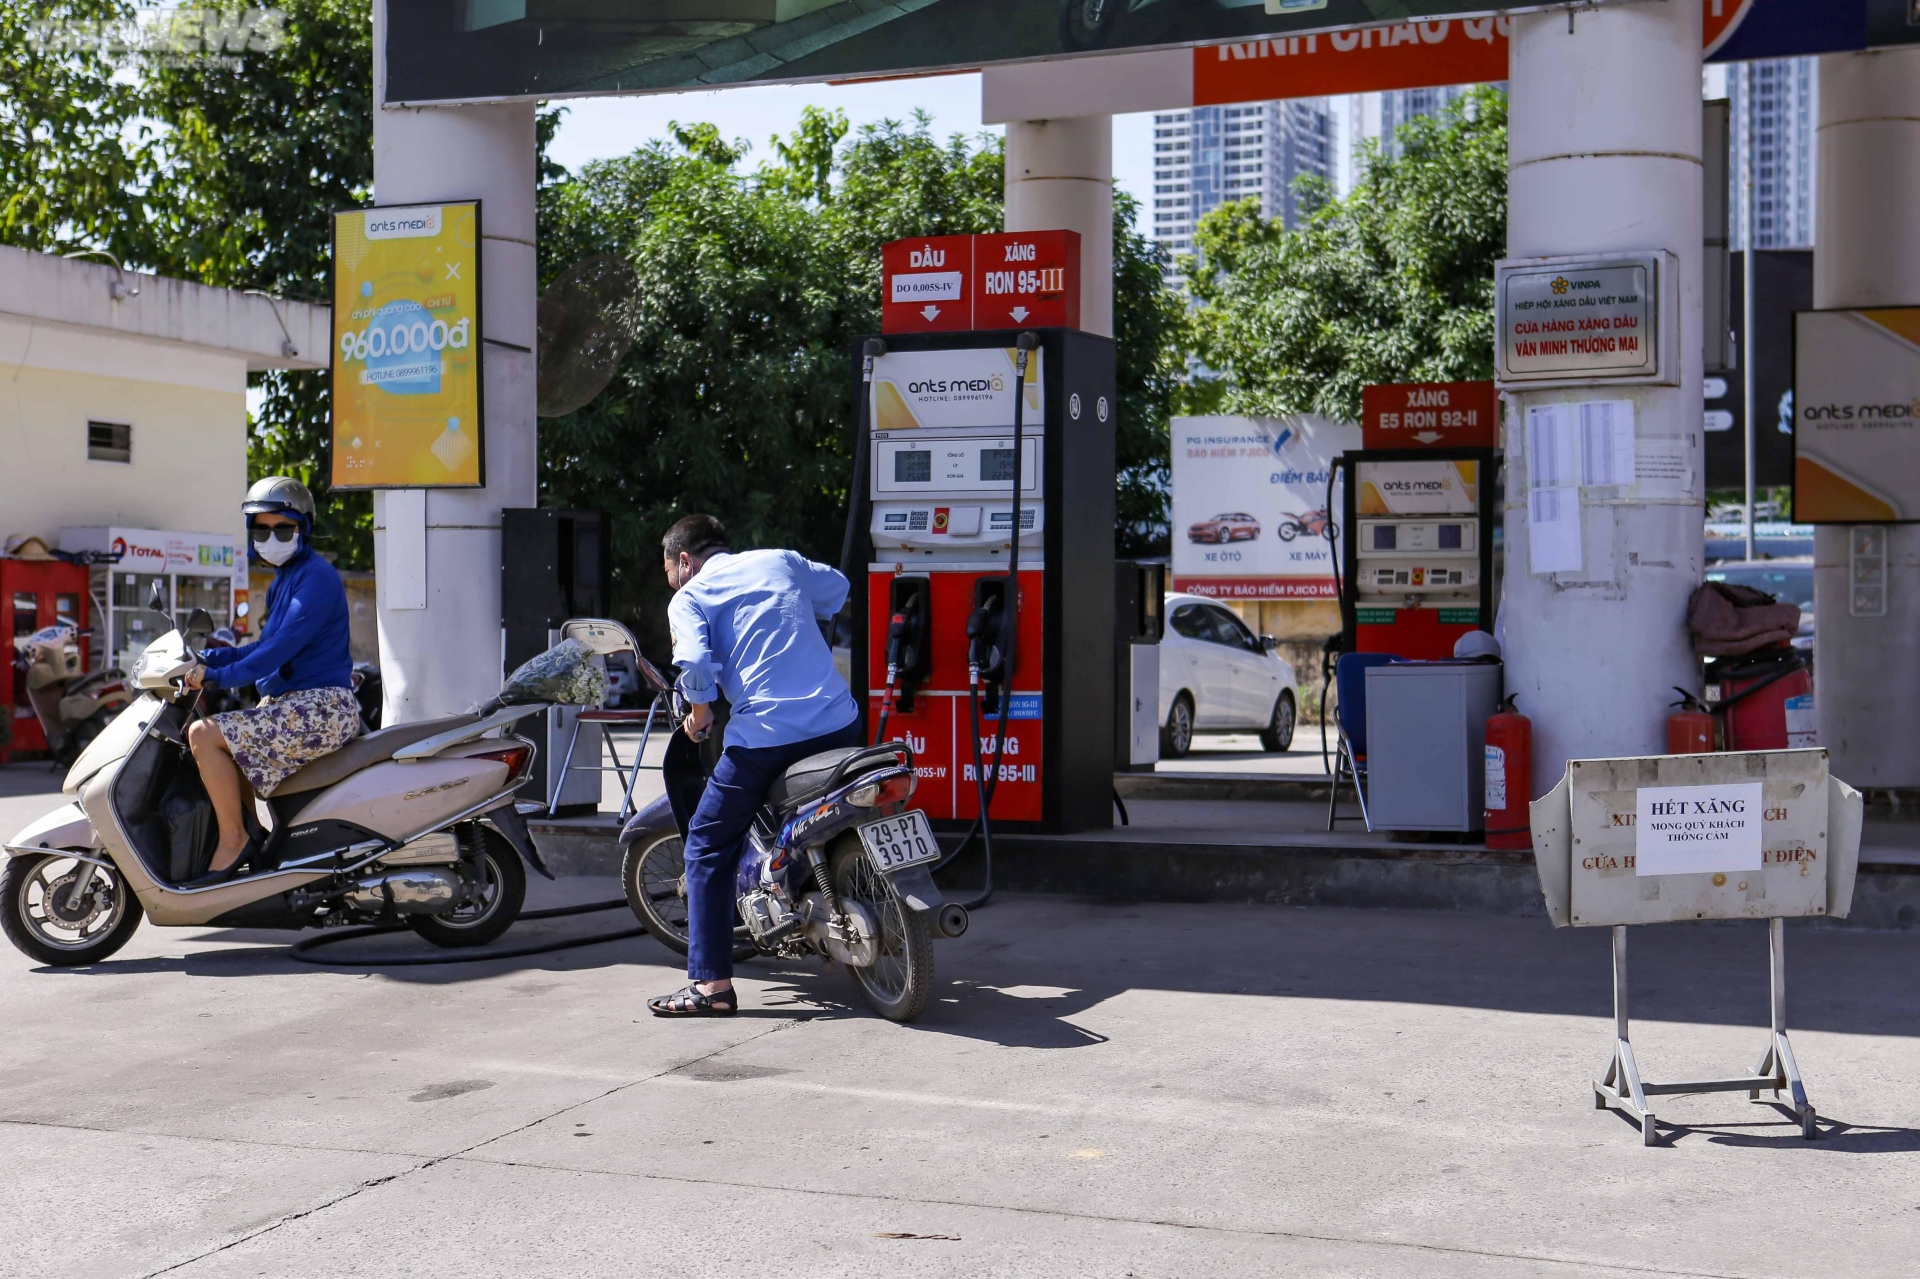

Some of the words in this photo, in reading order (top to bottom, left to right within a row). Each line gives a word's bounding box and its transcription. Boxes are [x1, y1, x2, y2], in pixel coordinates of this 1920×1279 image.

[370, 220, 396, 233] ants
[910, 244, 945, 268] DẦU
[1004, 241, 1036, 262] XĂNG
[896, 285, 911, 293] DO
[912, 282, 953, 293] 0,005S-IV
[985, 271, 1014, 295] RON
[1018, 267, 1064, 294] 95-III
[1570, 279, 1601, 290] VINPA
[1536, 299, 1551, 309] HỘI
[1553, 298, 1576, 308] XĂNG
[1579, 295, 1597, 307] DẦU
[1599, 295, 1616, 306] VIỆT
[1618, 295, 1638, 304] NAM
[1515, 319, 1539, 335] CỬA
[1542, 317, 1575, 333] HÀNG
[1578, 317, 1610, 331] XĂNG
[1614, 313, 1638, 329] DẦU
[340, 317, 470, 362] 960.000đ
[1515, 341, 1537, 357] VĂN
[1539, 340, 1567, 355] MINH
[1570, 336, 1616, 354] THƯƠNG
[1618, 336, 1638, 355] MẠI
[396, 365, 437, 379] 0899961196
[908, 379, 947, 394] ants
[1406, 389, 1449, 408] XĂNG
[1804, 402, 1854, 420] ants
[1379, 412, 1400, 429] E5
[1403, 411, 1437, 428] RON
[1441, 410, 1477, 427] 92-II
[1186, 437, 1202, 445] PG
[1204, 435, 1270, 445] INSURANCE
[1240, 447, 1270, 458] PJICO
[1270, 468, 1302, 484] ĐIỂM
[1383, 480, 1411, 491] ants
[129, 544, 165, 558] TOTAL
[1204, 552, 1218, 562] XE
[1220, 549, 1242, 562] ÔTÔ
[1289, 552, 1303, 561] XE
[1305, 549, 1328, 561] MÁY
[1186, 583, 1217, 596] CÔNG
[1219, 585, 1232, 595] TY
[1234, 583, 1256, 595] BẢO
[1258, 583, 1285, 595] HIỂM
[1286, 585, 1317, 595] PJICO
[1319, 583, 1334, 595] HÀ
[1650, 798, 1689, 815] HẾT
[1693, 797, 1745, 815] XĂNG
[871, 815, 919, 847] 29-P7
[1651, 822, 1682, 831] MONG
[1684, 819, 1707, 832] QUÝ
[1709, 820, 1745, 830] KHÁCH
[1667, 831, 1703, 842] THÔNG
[1705, 831, 1729, 841] CẢM
[878, 837, 929, 866] 3970
[1582, 852, 1618, 870] CỬA
[1776, 846, 1817, 865] ĐIỆN
